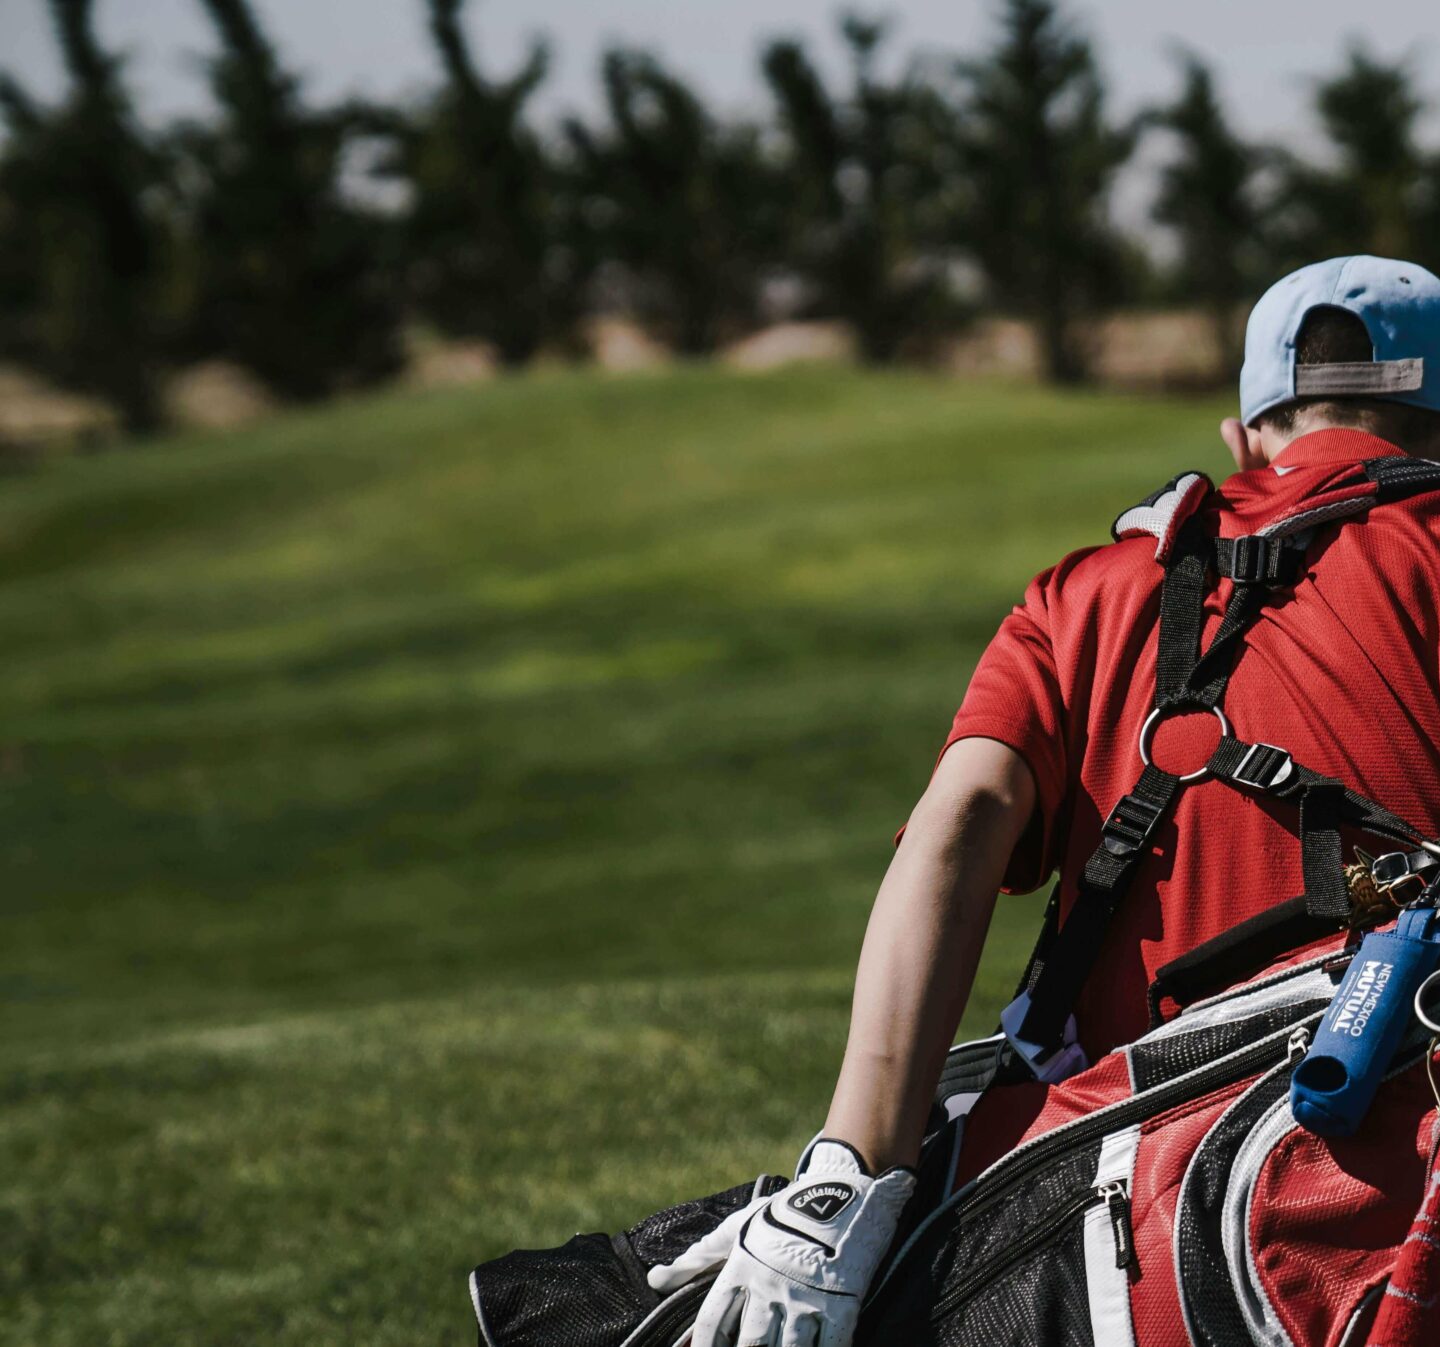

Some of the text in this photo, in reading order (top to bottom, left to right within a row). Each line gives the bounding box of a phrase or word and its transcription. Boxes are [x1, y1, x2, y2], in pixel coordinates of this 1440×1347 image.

[1332, 961, 1382, 1033] MUTUAL
[1350, 963, 1394, 1037] NEW MEXICO
[793, 1186, 850, 1208] Callaway
